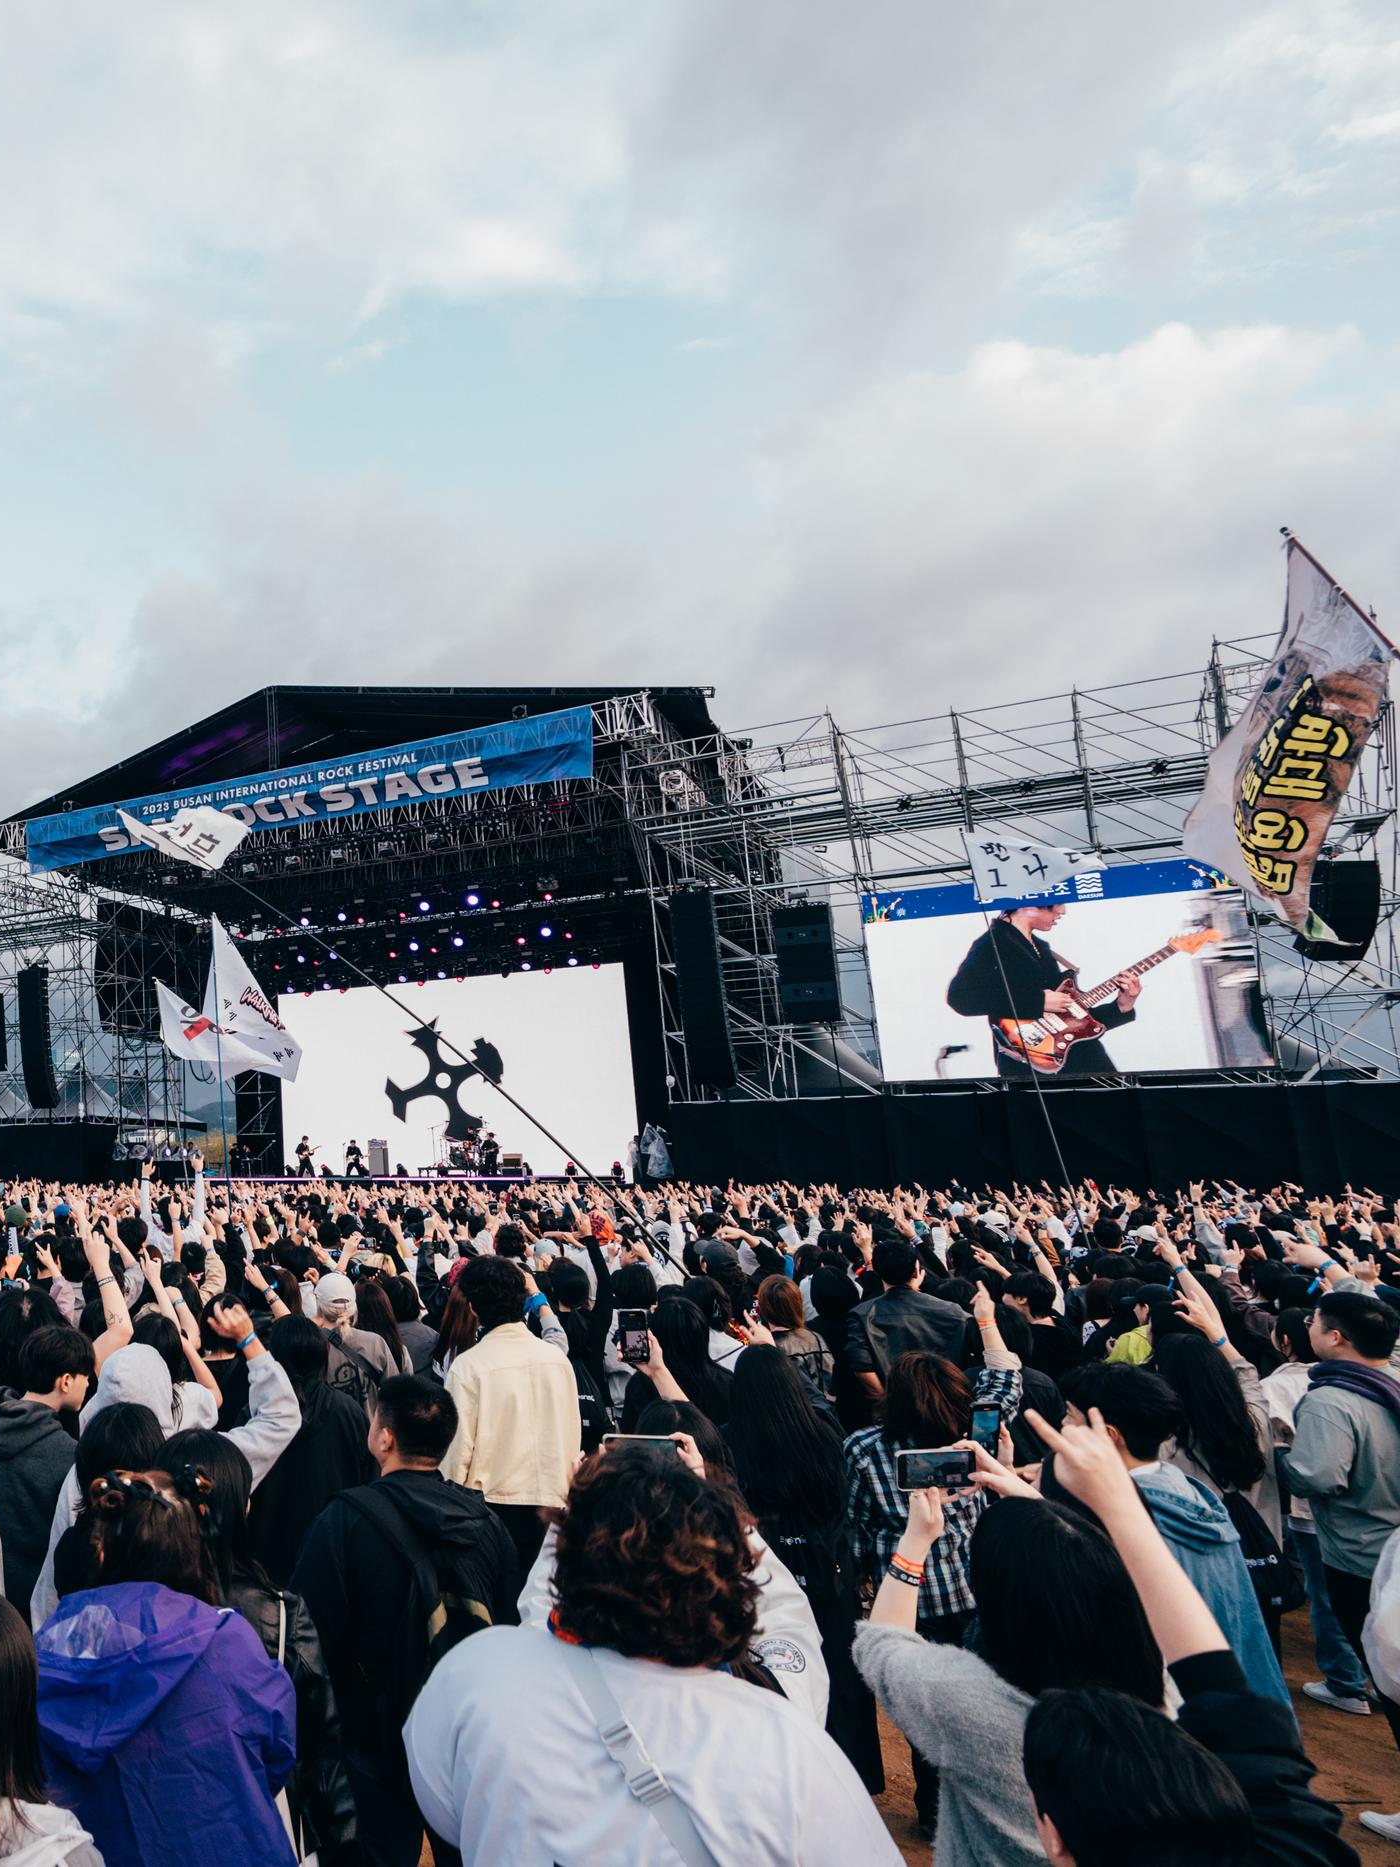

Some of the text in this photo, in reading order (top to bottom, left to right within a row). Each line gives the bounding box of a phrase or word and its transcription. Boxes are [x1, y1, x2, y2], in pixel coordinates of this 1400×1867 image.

[98, 791, 317, 852] SOCK
[320, 756, 489, 812] STAGE
[142, 752, 418, 815] 2023 BUSAN INTERNATIONAL ROCK FESTIVAL
